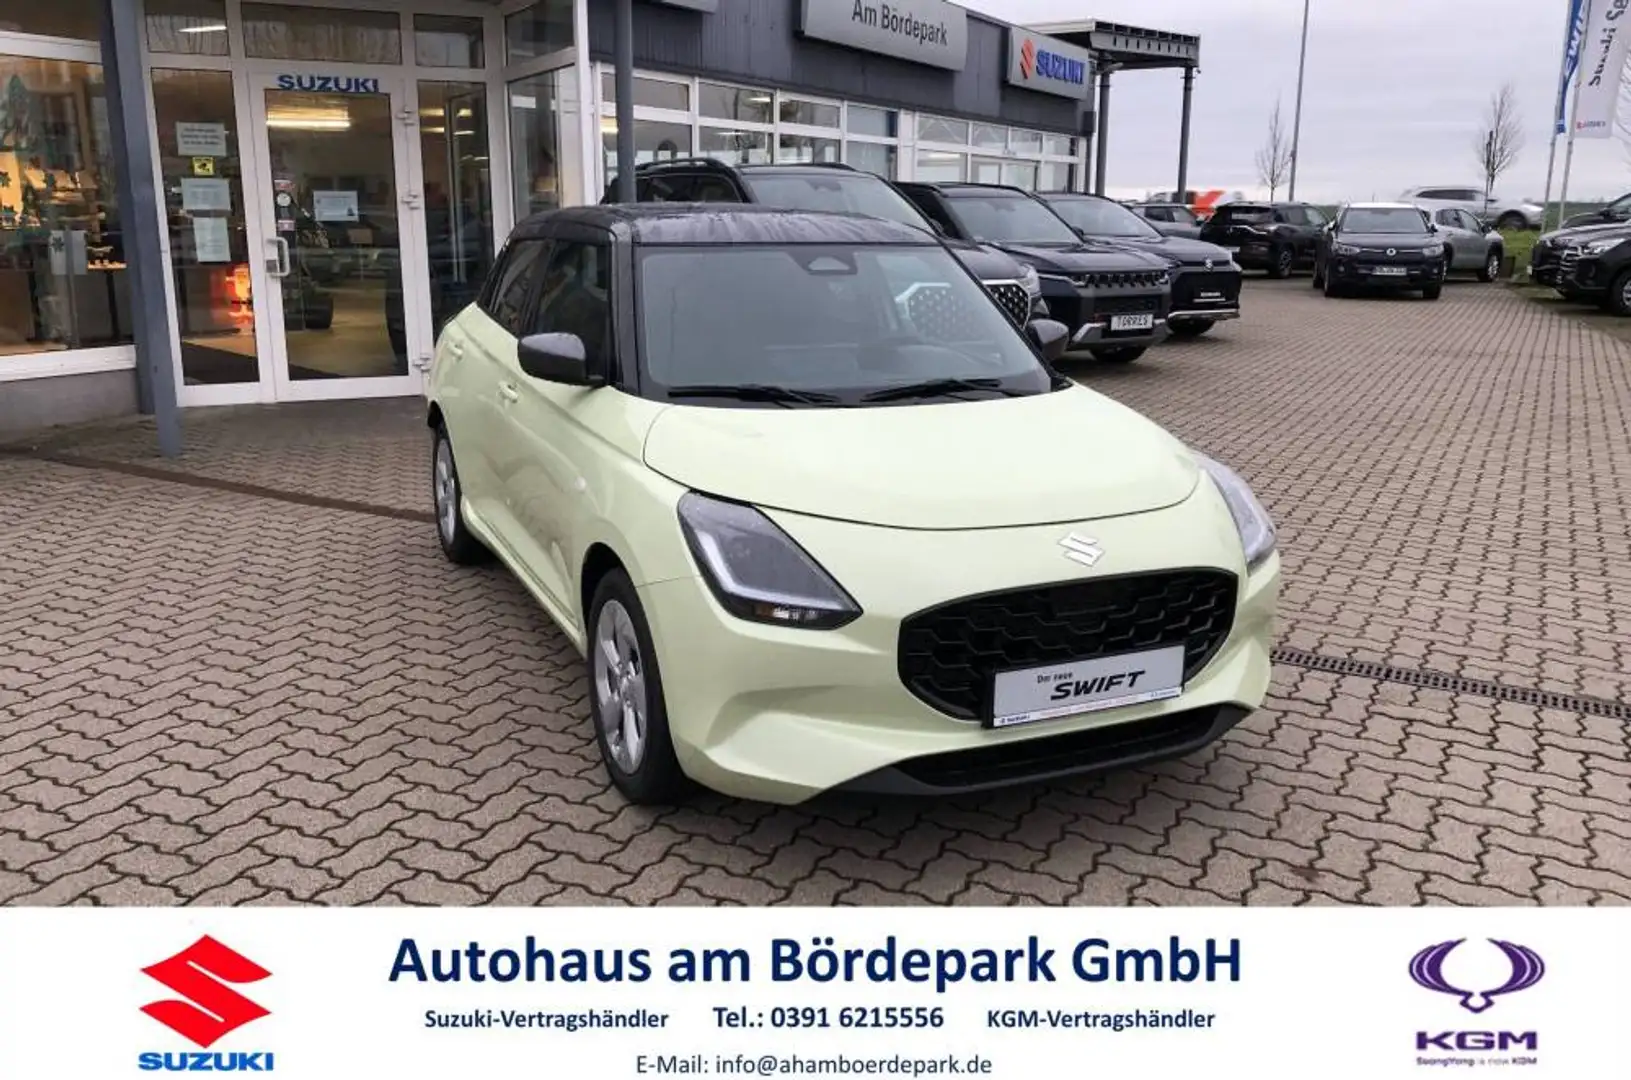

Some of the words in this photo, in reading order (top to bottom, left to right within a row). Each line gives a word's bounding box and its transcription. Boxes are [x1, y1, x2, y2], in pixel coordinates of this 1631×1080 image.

[852, 0, 877, 26] Am
[882, 3, 948, 46] Bördepark
[277, 74, 379, 93] SUZUKI
[1036, 49, 1086, 85] SUZUKI
[1050, 669, 1146, 701] SWIFT
